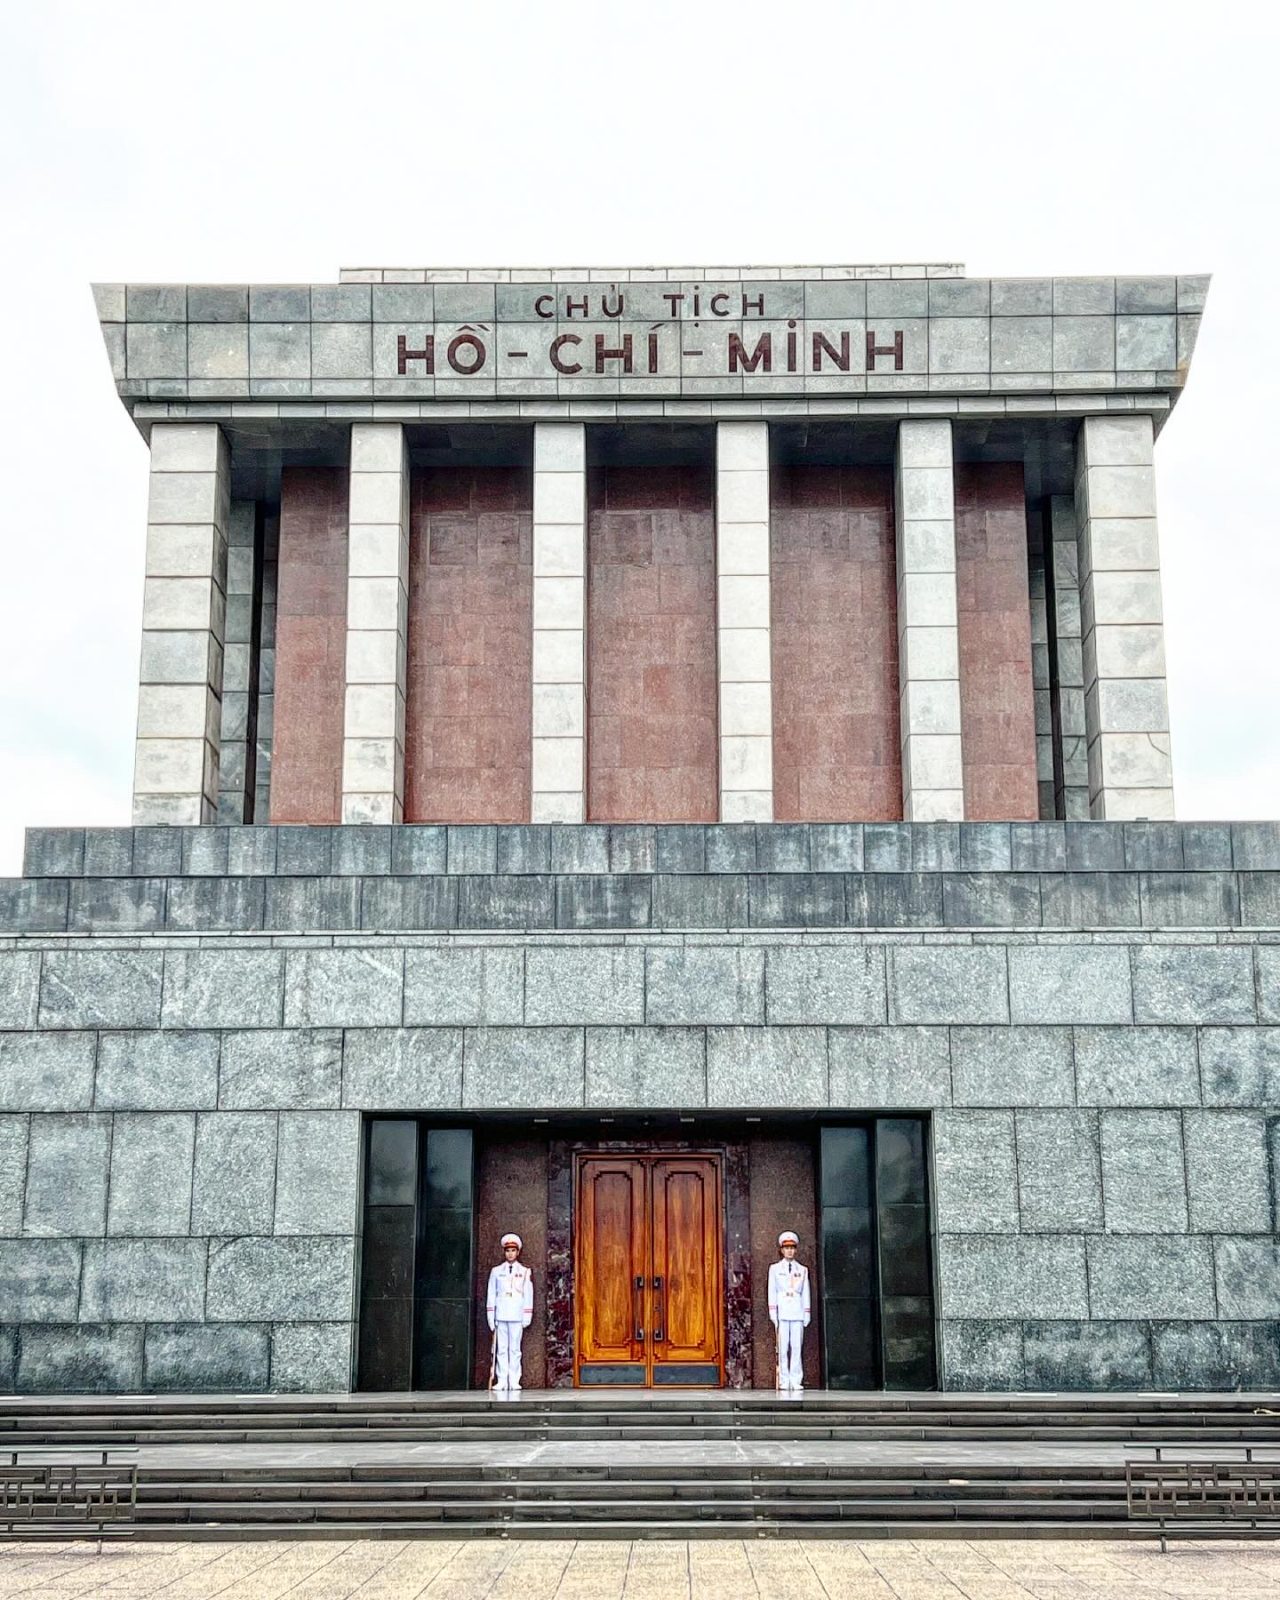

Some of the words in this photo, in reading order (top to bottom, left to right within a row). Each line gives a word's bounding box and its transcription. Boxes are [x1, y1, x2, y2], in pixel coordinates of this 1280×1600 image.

[534, 284, 624, 318] CHỦ
[397, 324, 490, 375] HỒ
[549, 323, 665, 374] CHÍ
